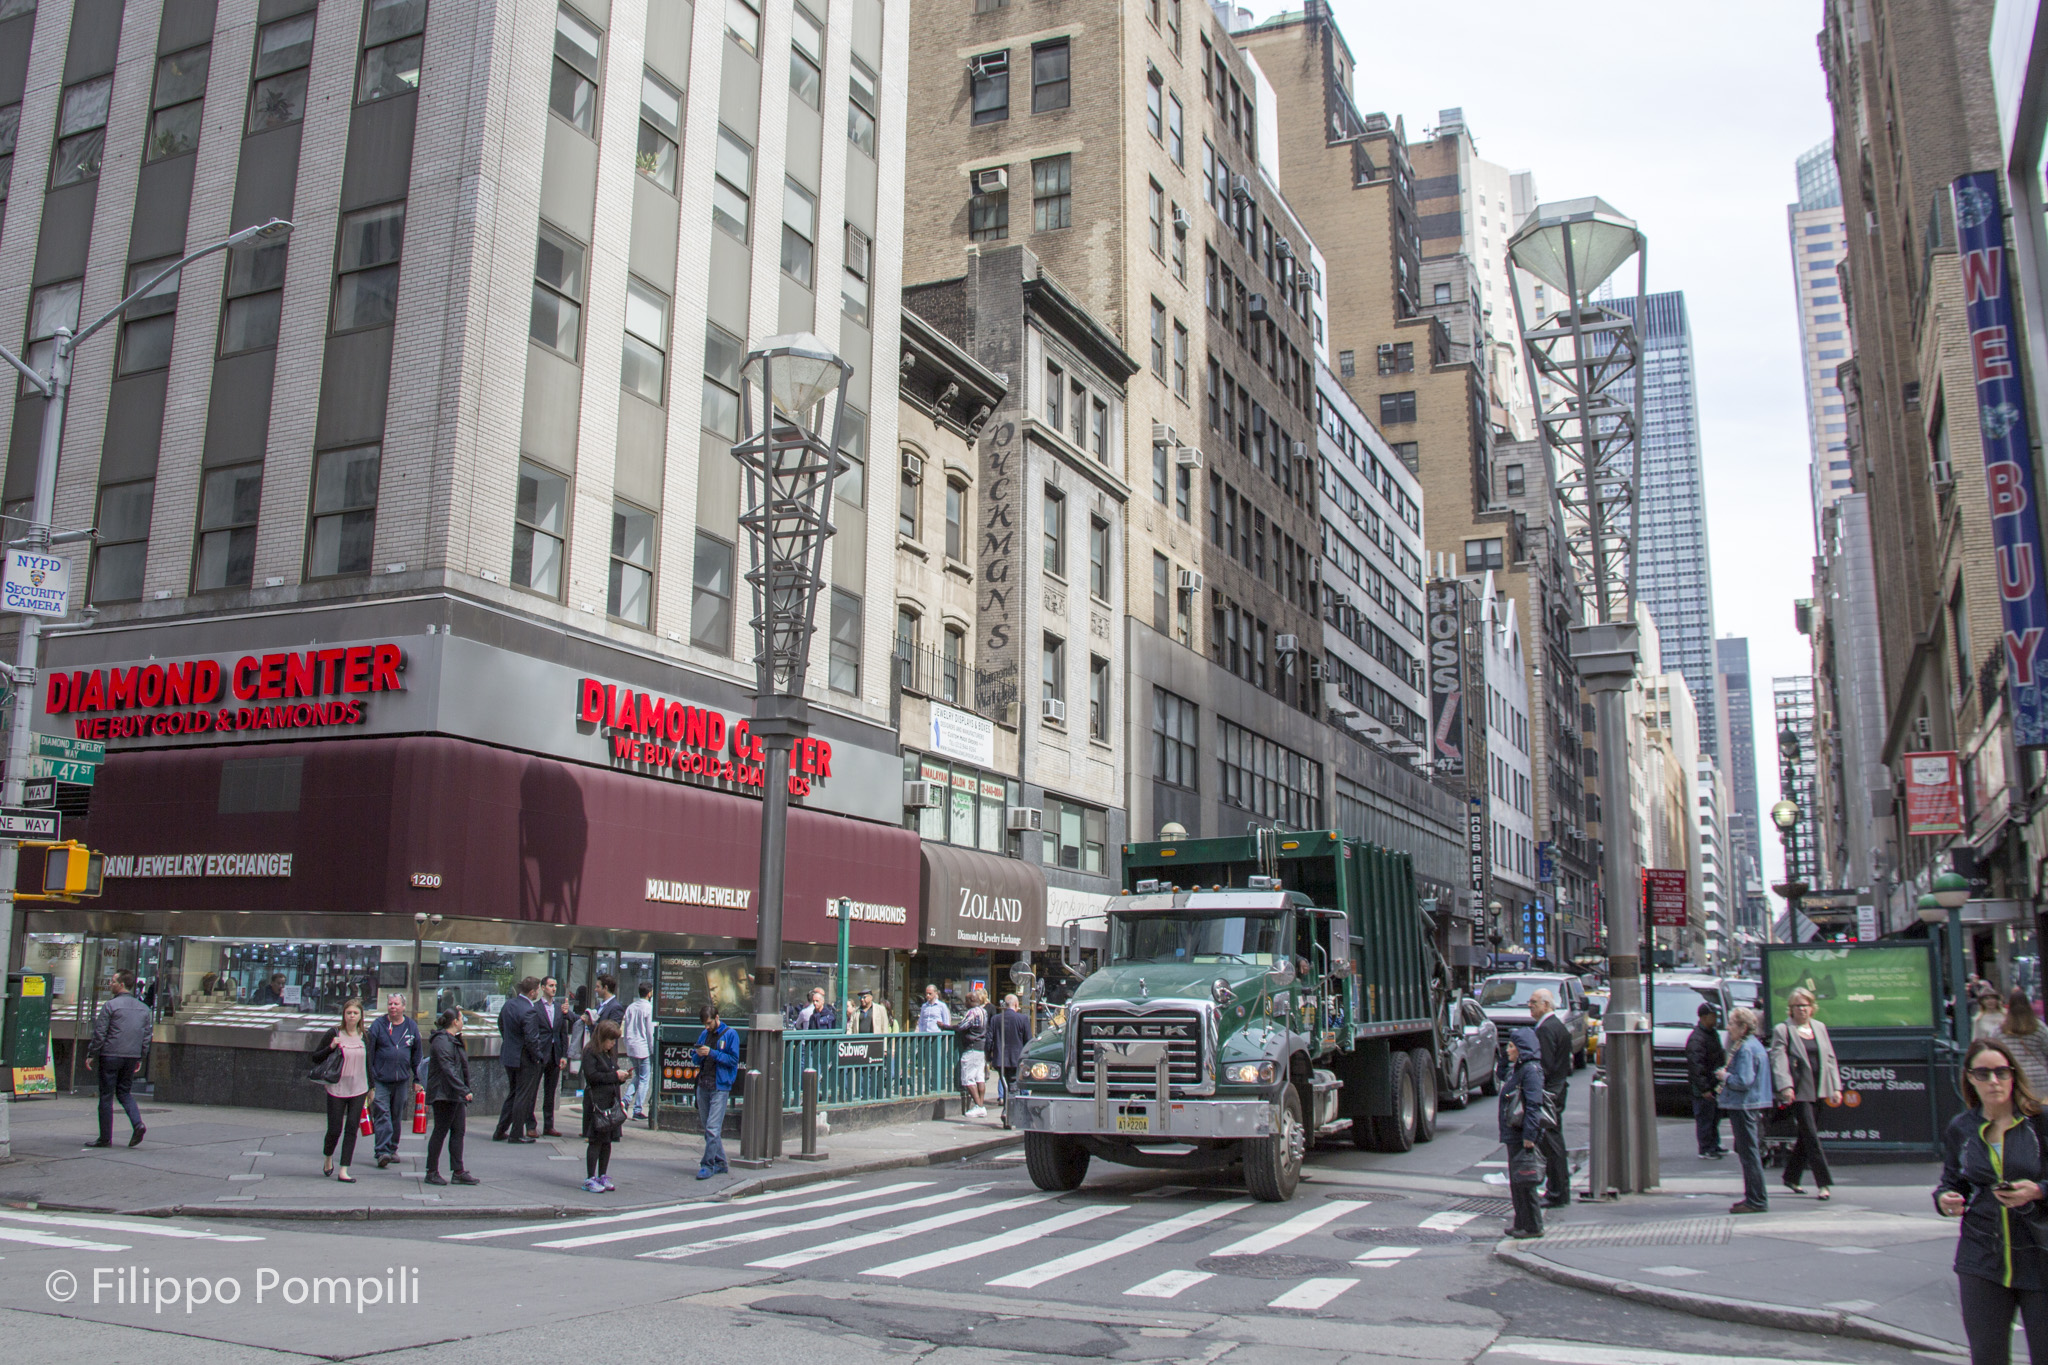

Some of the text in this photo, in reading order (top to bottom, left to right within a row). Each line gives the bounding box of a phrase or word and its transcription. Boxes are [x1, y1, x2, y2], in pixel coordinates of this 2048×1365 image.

[17, 555, 61, 572] NYPD
[1987, 460, 2045, 688] BUY
[5, 581, 66, 600] SECURITY
[7, 594, 61, 612] CAMERA
[1429, 586, 1459, 694] ROSS
[45, 643, 403, 715] DIAMOND CENTER
[75, 700, 361, 740] WE BUY GOLD & DIAMONDS
[582, 677, 833, 778] DIAMOND CETER
[41, 735, 103, 753] DIAMOND JEWELRY
[64, 749, 79, 759] WAY
[614, 735, 641, 762] WE
[644, 742, 677, 768] BUY
[677, 749, 722, 778] GOLD
[723, 761, 736, 782] &
[59, 763, 79, 781] 47
[81, 765, 92, 775] ST
[28, 786, 48, 799] WAY
[0, 817, 50, 831] NE WAY
[1471, 816, 1481, 851] ROSS
[133, 854, 204, 877] JEWELRY
[205, 853, 292, 877] EXCHANGE
[411, 873, 442, 889] 1200
[646, 878, 751, 910] MALIDANI JEWELRY
[1472, 855, 1484, 926] REFINERS
[826, 898, 907, 925] FAASY DIAMONDS
[959, 887, 1022, 923] ZOLAND
[930, 928, 936, 937] 75
[1535, 900, 1545, 958] LOANS
[958, 930, 1022, 947] Diamond & Jewelry Exchange
[1091, 1024, 1189, 1037] MACK
[839, 1043, 868, 1058] Subway
[1840, 1067, 1896, 1080] Streets
[1847, 1080, 1884, 1090] Center
[1886, 1080, 1926, 1090] Station
[1841, 1131, 1851, 1139] at
[1853, 1130, 1867, 1139] 49
[1868, 1130, 1881, 1139] St
